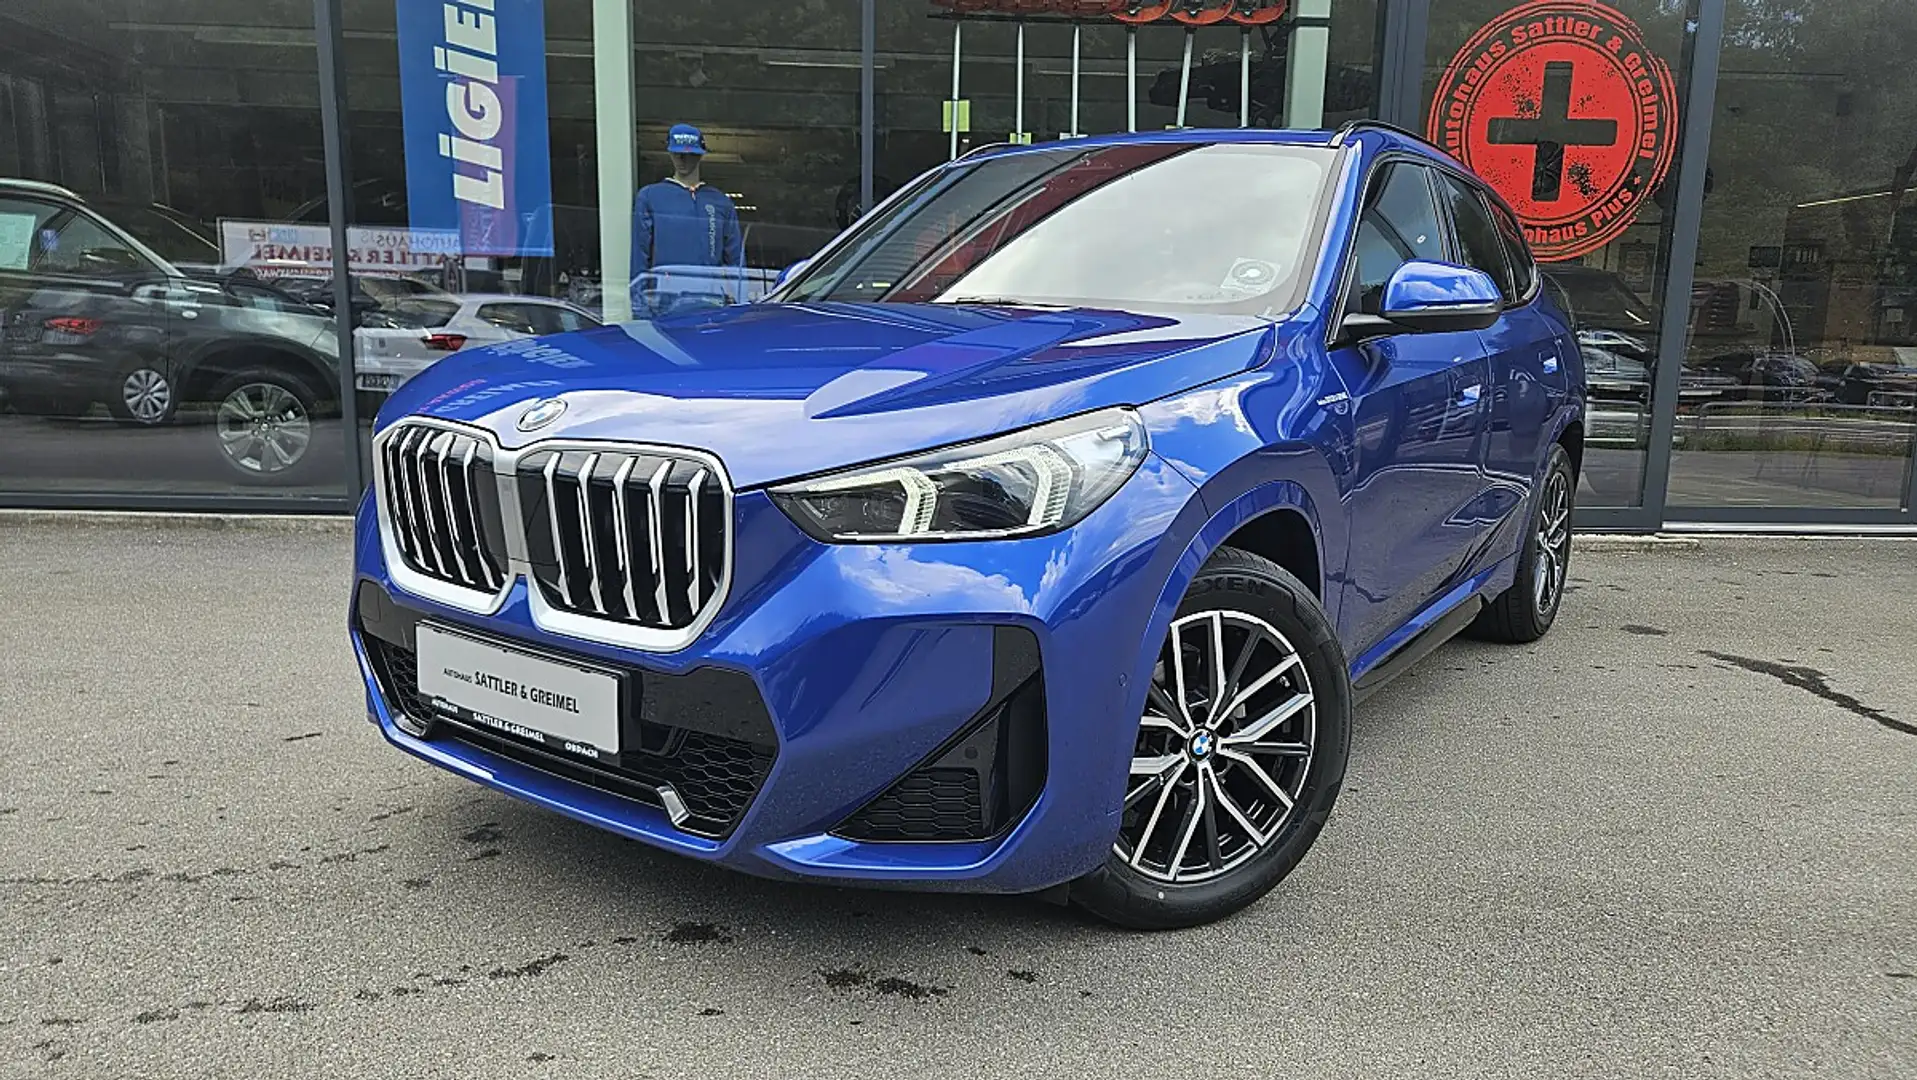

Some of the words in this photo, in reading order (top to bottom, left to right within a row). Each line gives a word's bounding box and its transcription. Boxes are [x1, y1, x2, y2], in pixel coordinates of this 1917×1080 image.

[433, 0, 504, 210] LiGiE
[1511, 16, 1603, 44] Sattler
[1605, 35, 1623, 54] &
[1624, 52, 1659, 159] Greimel
[1523, 221, 1588, 243] ohaus
[1590, 188, 1633, 228] Plus
[475, 671, 518, 697] SATTLER
[520, 684, 528, 700] &
[530, 687, 580, 714] GREIMEL
